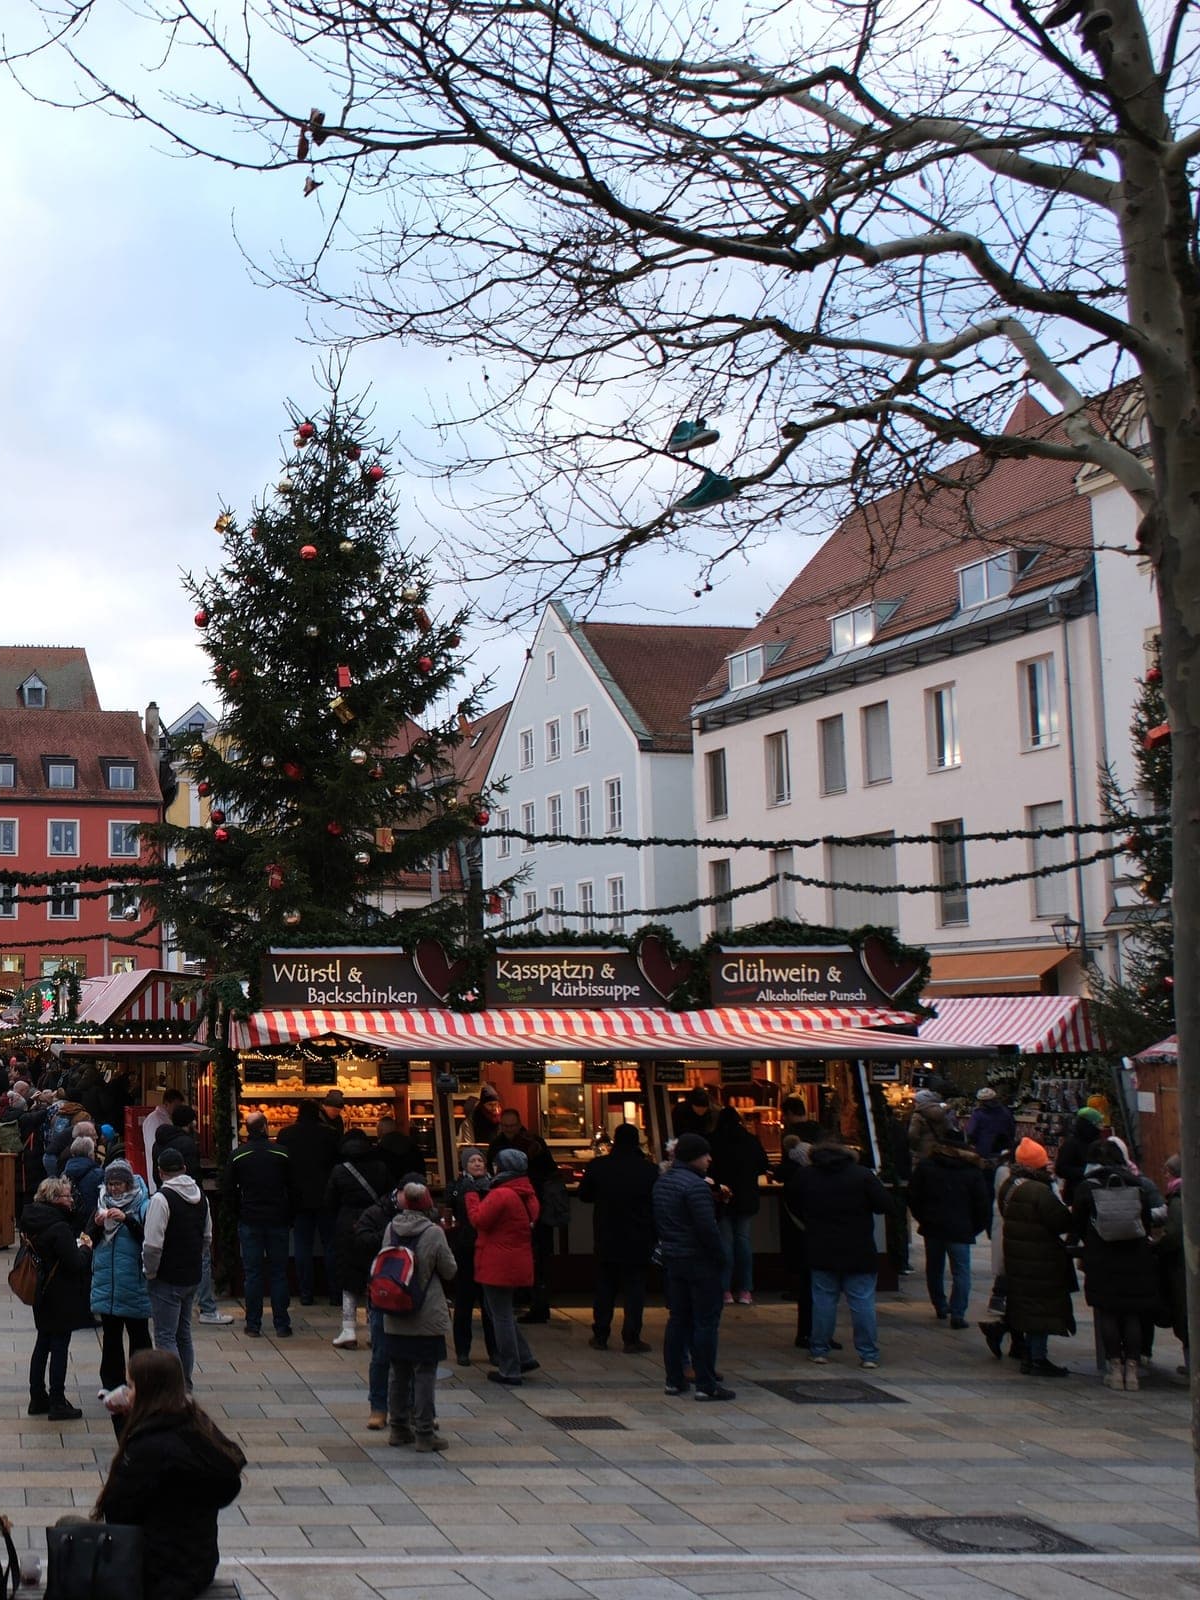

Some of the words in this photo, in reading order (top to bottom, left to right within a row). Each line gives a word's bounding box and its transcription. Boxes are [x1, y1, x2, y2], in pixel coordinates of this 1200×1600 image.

[272, 959, 341, 983] Würstl
[347, 967, 363, 983] &
[496, 959, 594, 985] Kasspatzn
[600, 963, 615, 980] &
[721, 958, 820, 983] Glühwein
[826, 966, 842, 983] &
[308, 985, 418, 1005] Backschinken
[551, 981, 640, 1001] Kürbissuppe
[756, 987, 828, 1002] Alkoholfreier
[830, 987, 867, 1002] Punsch
